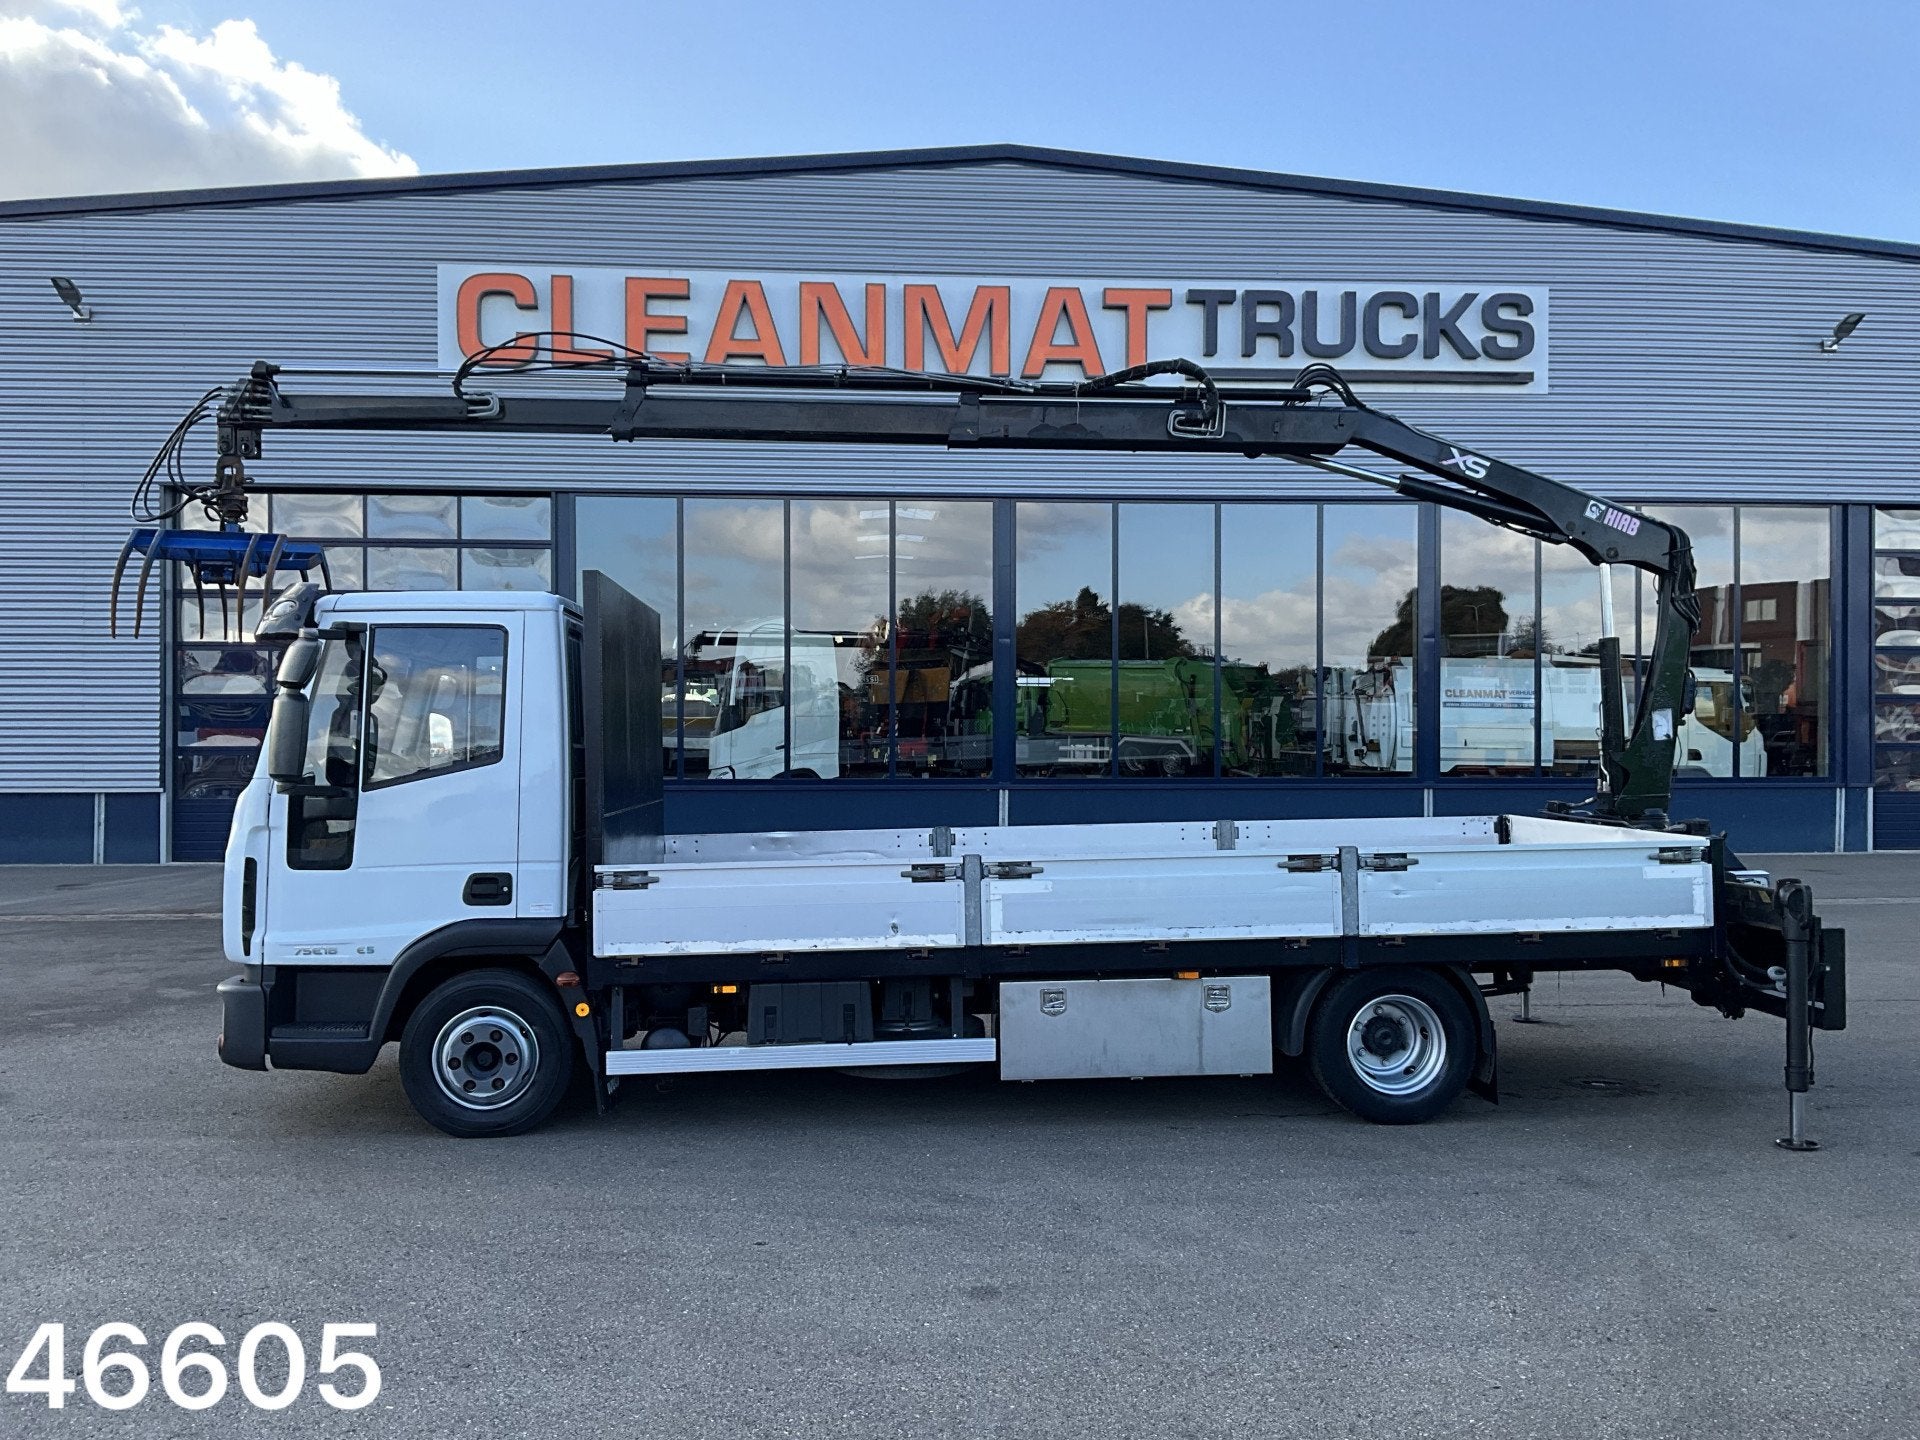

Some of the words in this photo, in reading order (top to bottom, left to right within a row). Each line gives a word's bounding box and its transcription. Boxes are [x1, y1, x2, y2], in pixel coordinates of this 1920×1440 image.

[456, 272, 1173, 379] CLEANMAT
[1186, 288, 1535, 361] TRUCKS
[1439, 447, 1491, 479] XS
[1603, 507, 1641, 536] HIAB
[1444, 689, 1508, 699] CLEANMAT
